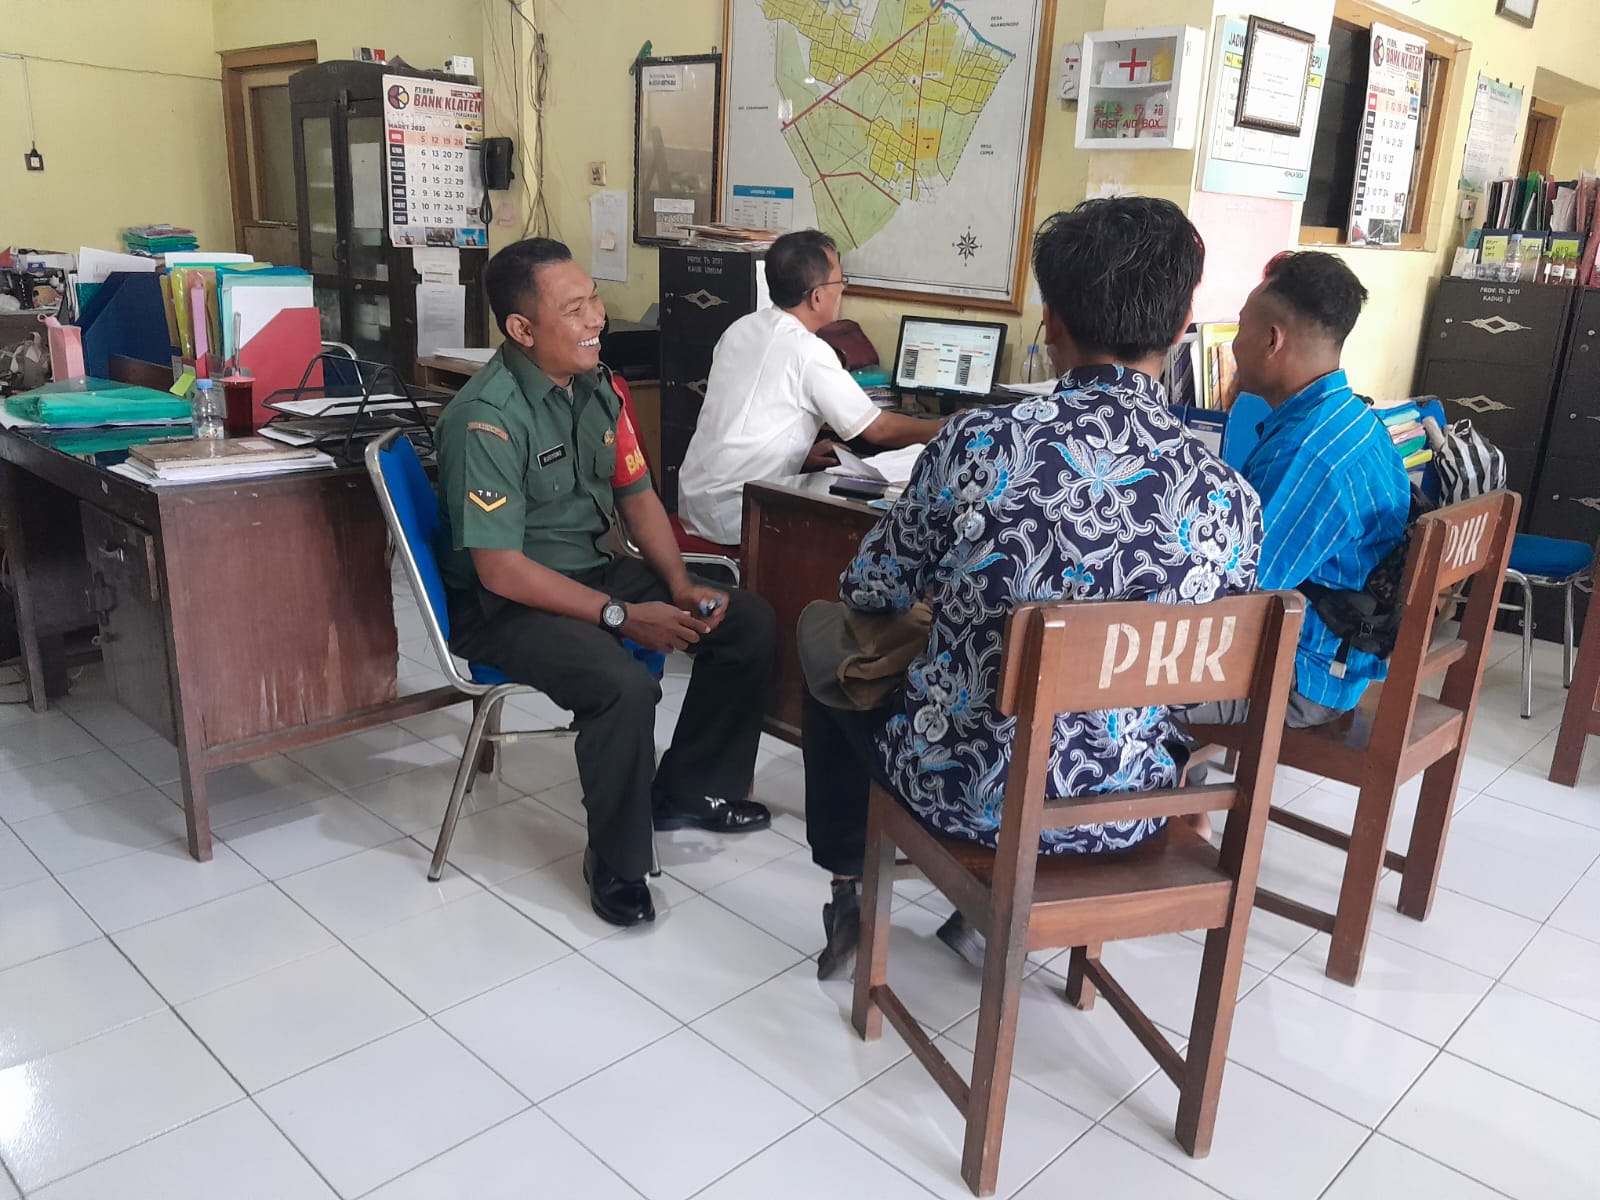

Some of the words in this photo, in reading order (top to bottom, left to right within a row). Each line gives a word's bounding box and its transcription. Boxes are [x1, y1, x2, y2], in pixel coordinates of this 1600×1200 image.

[413, 94, 442, 109] BANK
[445, 96, 481, 113] KLATEN
[1094, 119, 1119, 129] FIRST
[1122, 119, 1138, 129] AID
[1143, 118, 1161, 129] BOX
[431, 136, 439, 144] 12
[478, 490, 498, 498] TNI
[1445, 512, 1489, 570] PKK
[1099, 616, 1236, 689] PKK
